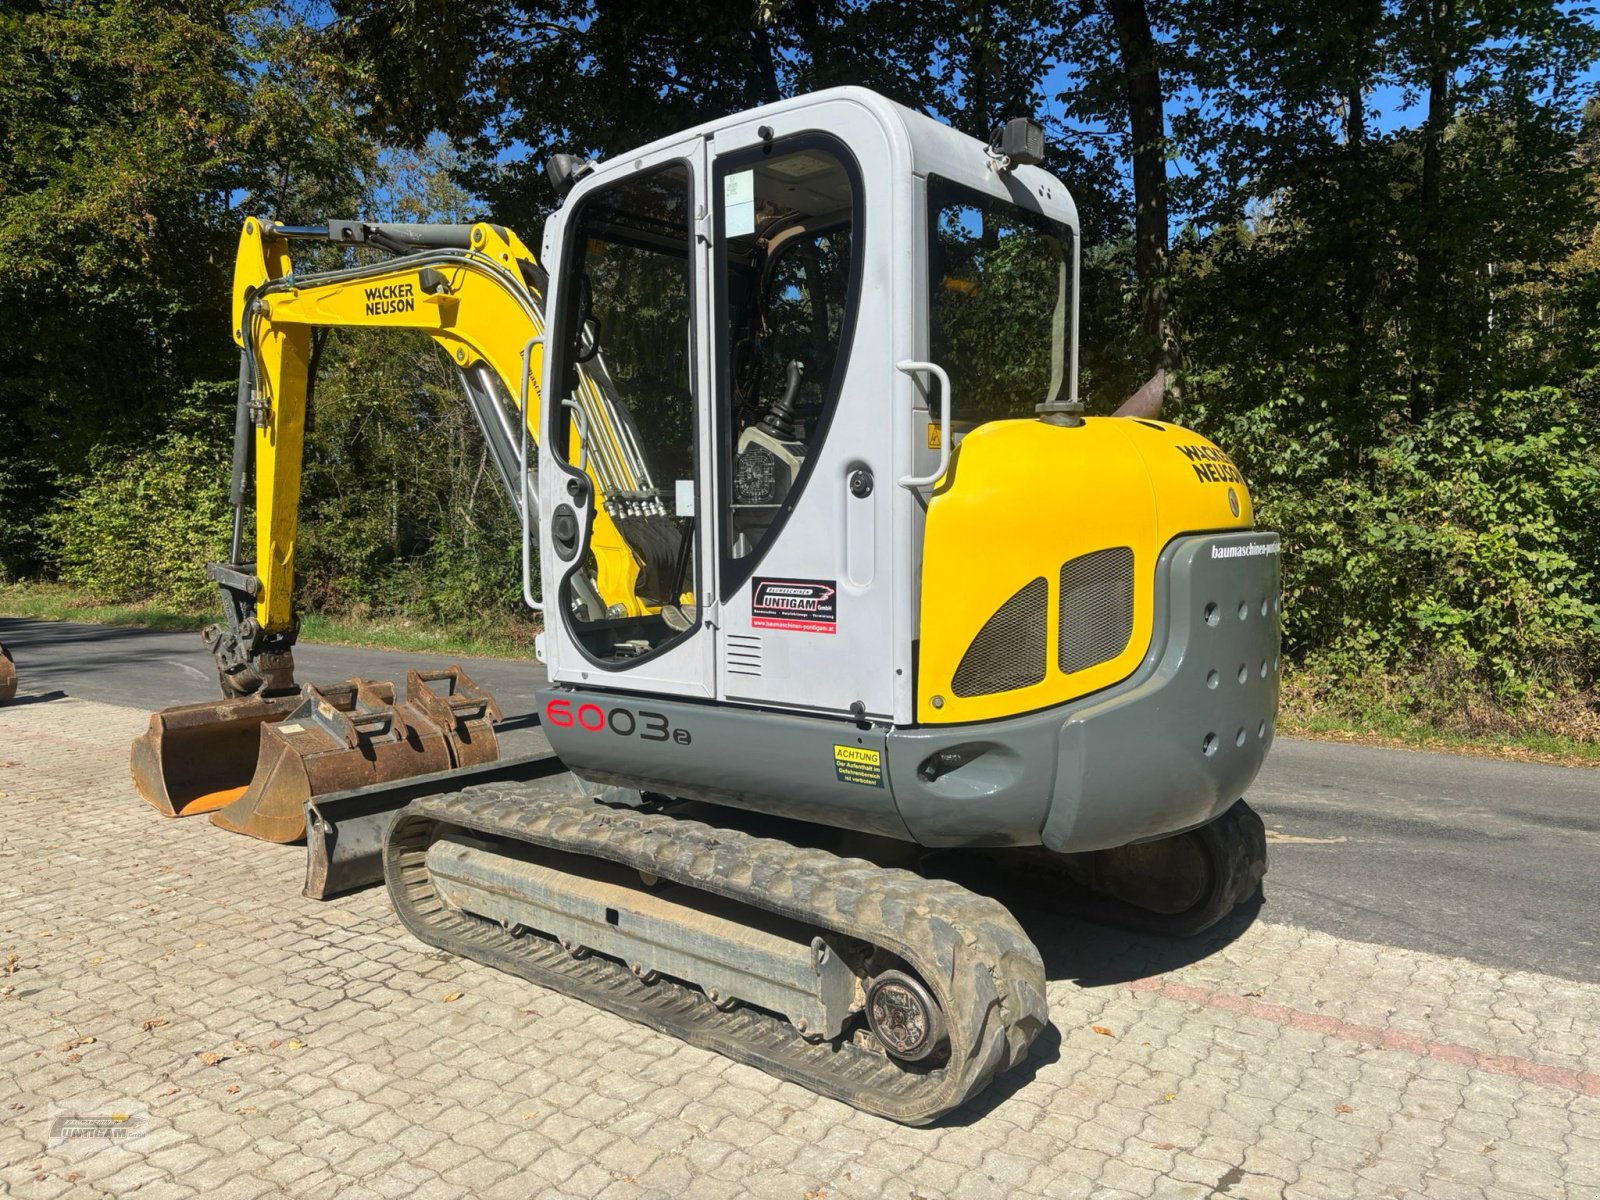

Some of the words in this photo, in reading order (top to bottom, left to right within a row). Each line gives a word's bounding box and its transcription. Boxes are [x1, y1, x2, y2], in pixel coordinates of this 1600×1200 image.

[364, 283, 414, 301] WACKER
[365, 298, 415, 316] NEUSON
[837, 749, 878, 762] ACHTUNG
